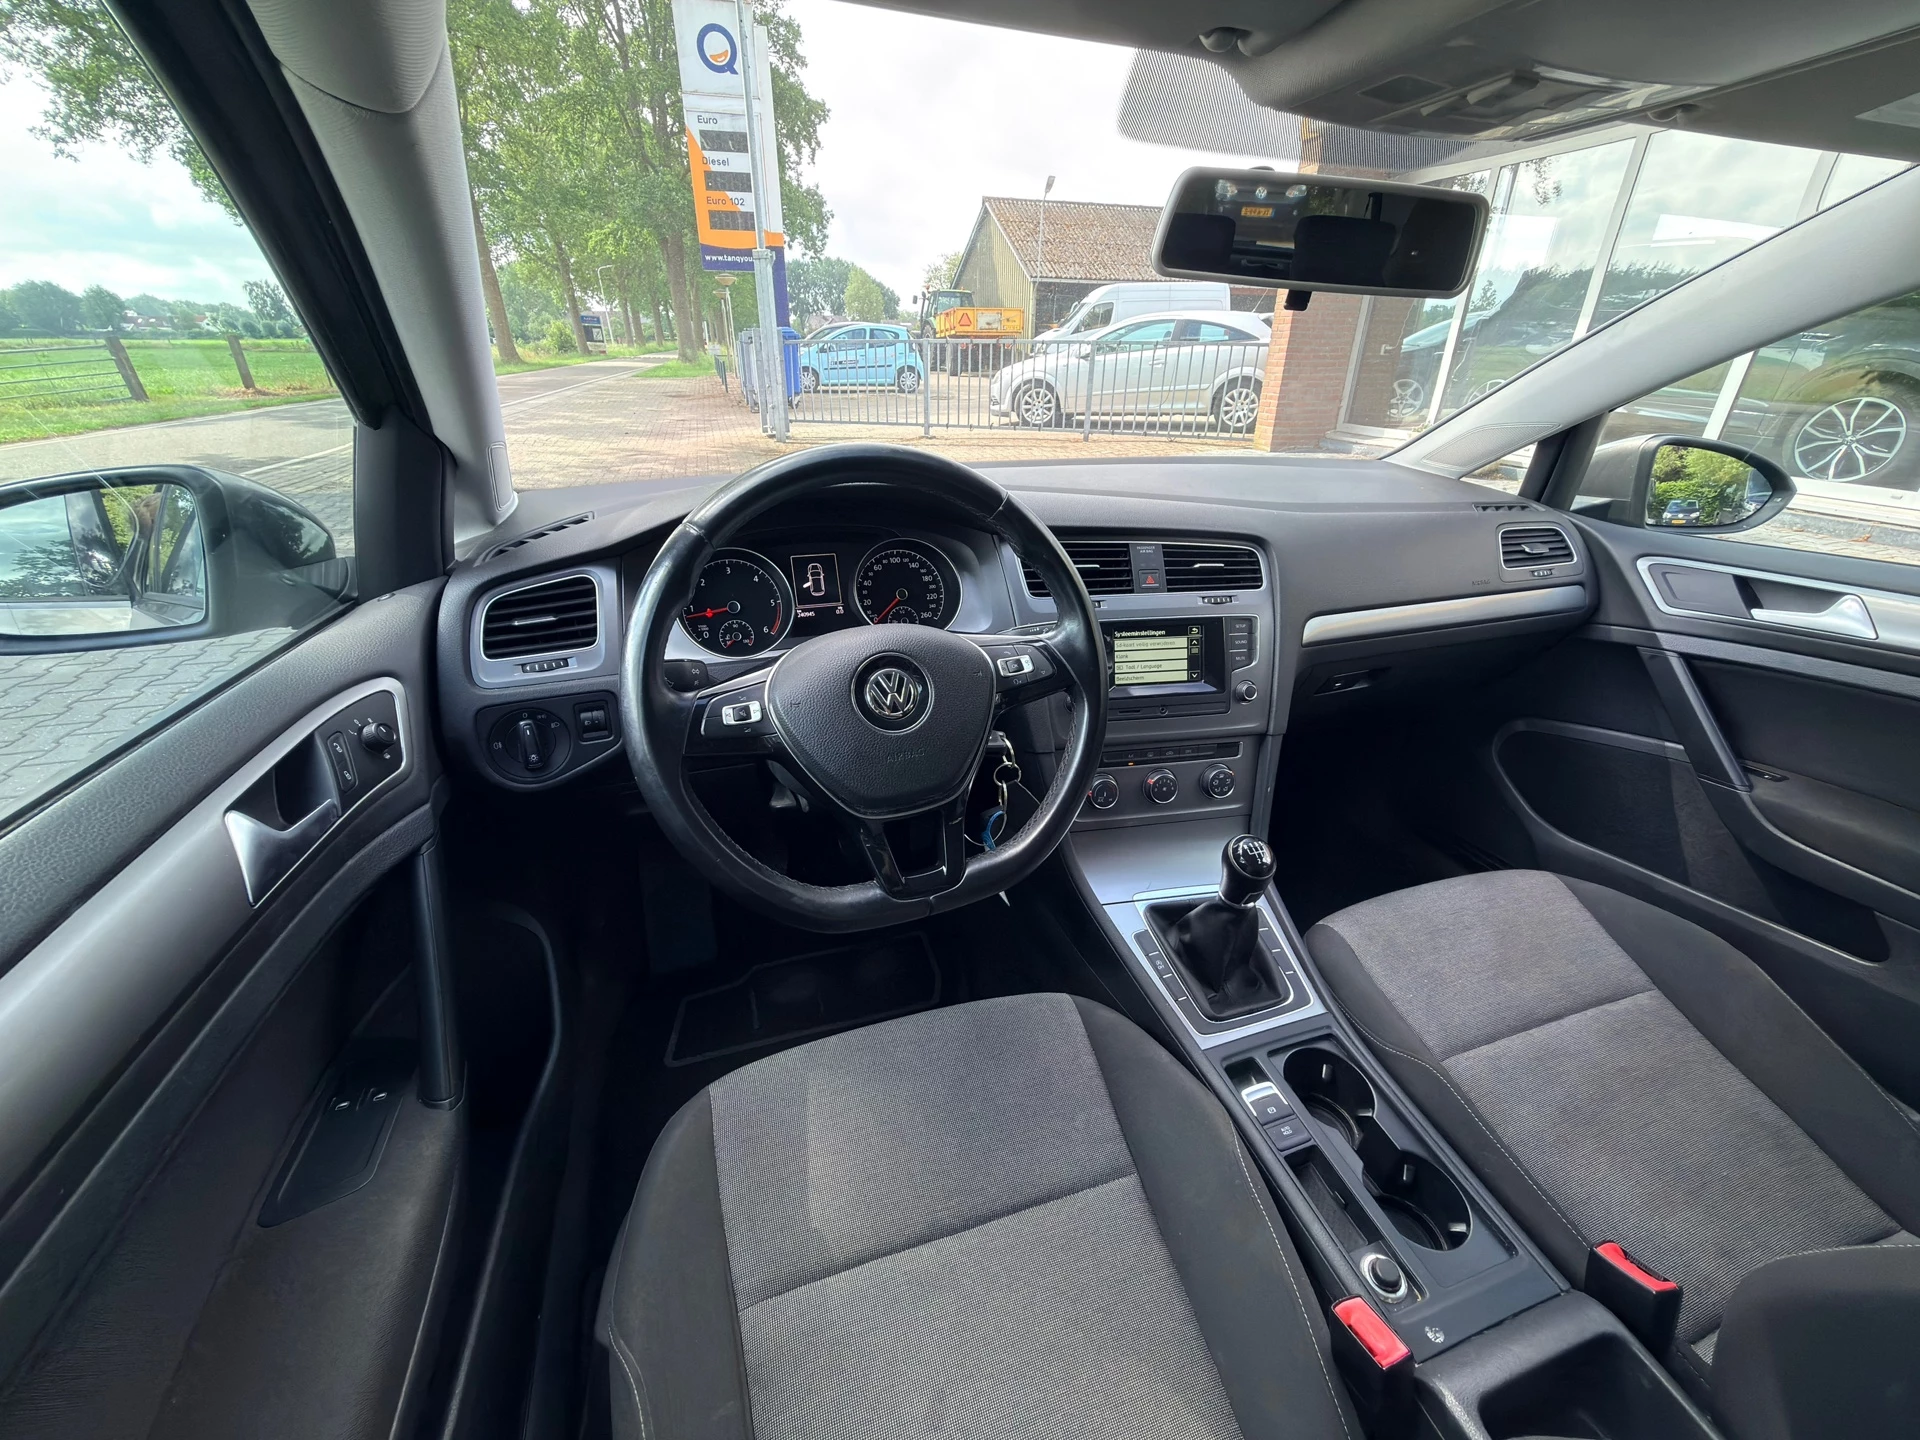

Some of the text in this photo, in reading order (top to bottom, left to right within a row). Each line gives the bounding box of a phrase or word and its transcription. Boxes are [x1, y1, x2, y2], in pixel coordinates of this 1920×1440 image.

[697, 115, 718, 125] Euro
[702, 156, 730, 167] Diesel
[706, 196, 745, 207] Euro 102
[700, 578, 706, 586] 2
[920, 611, 932, 619] 260
[1114, 630, 1166, 638] Systeeminstellingen
